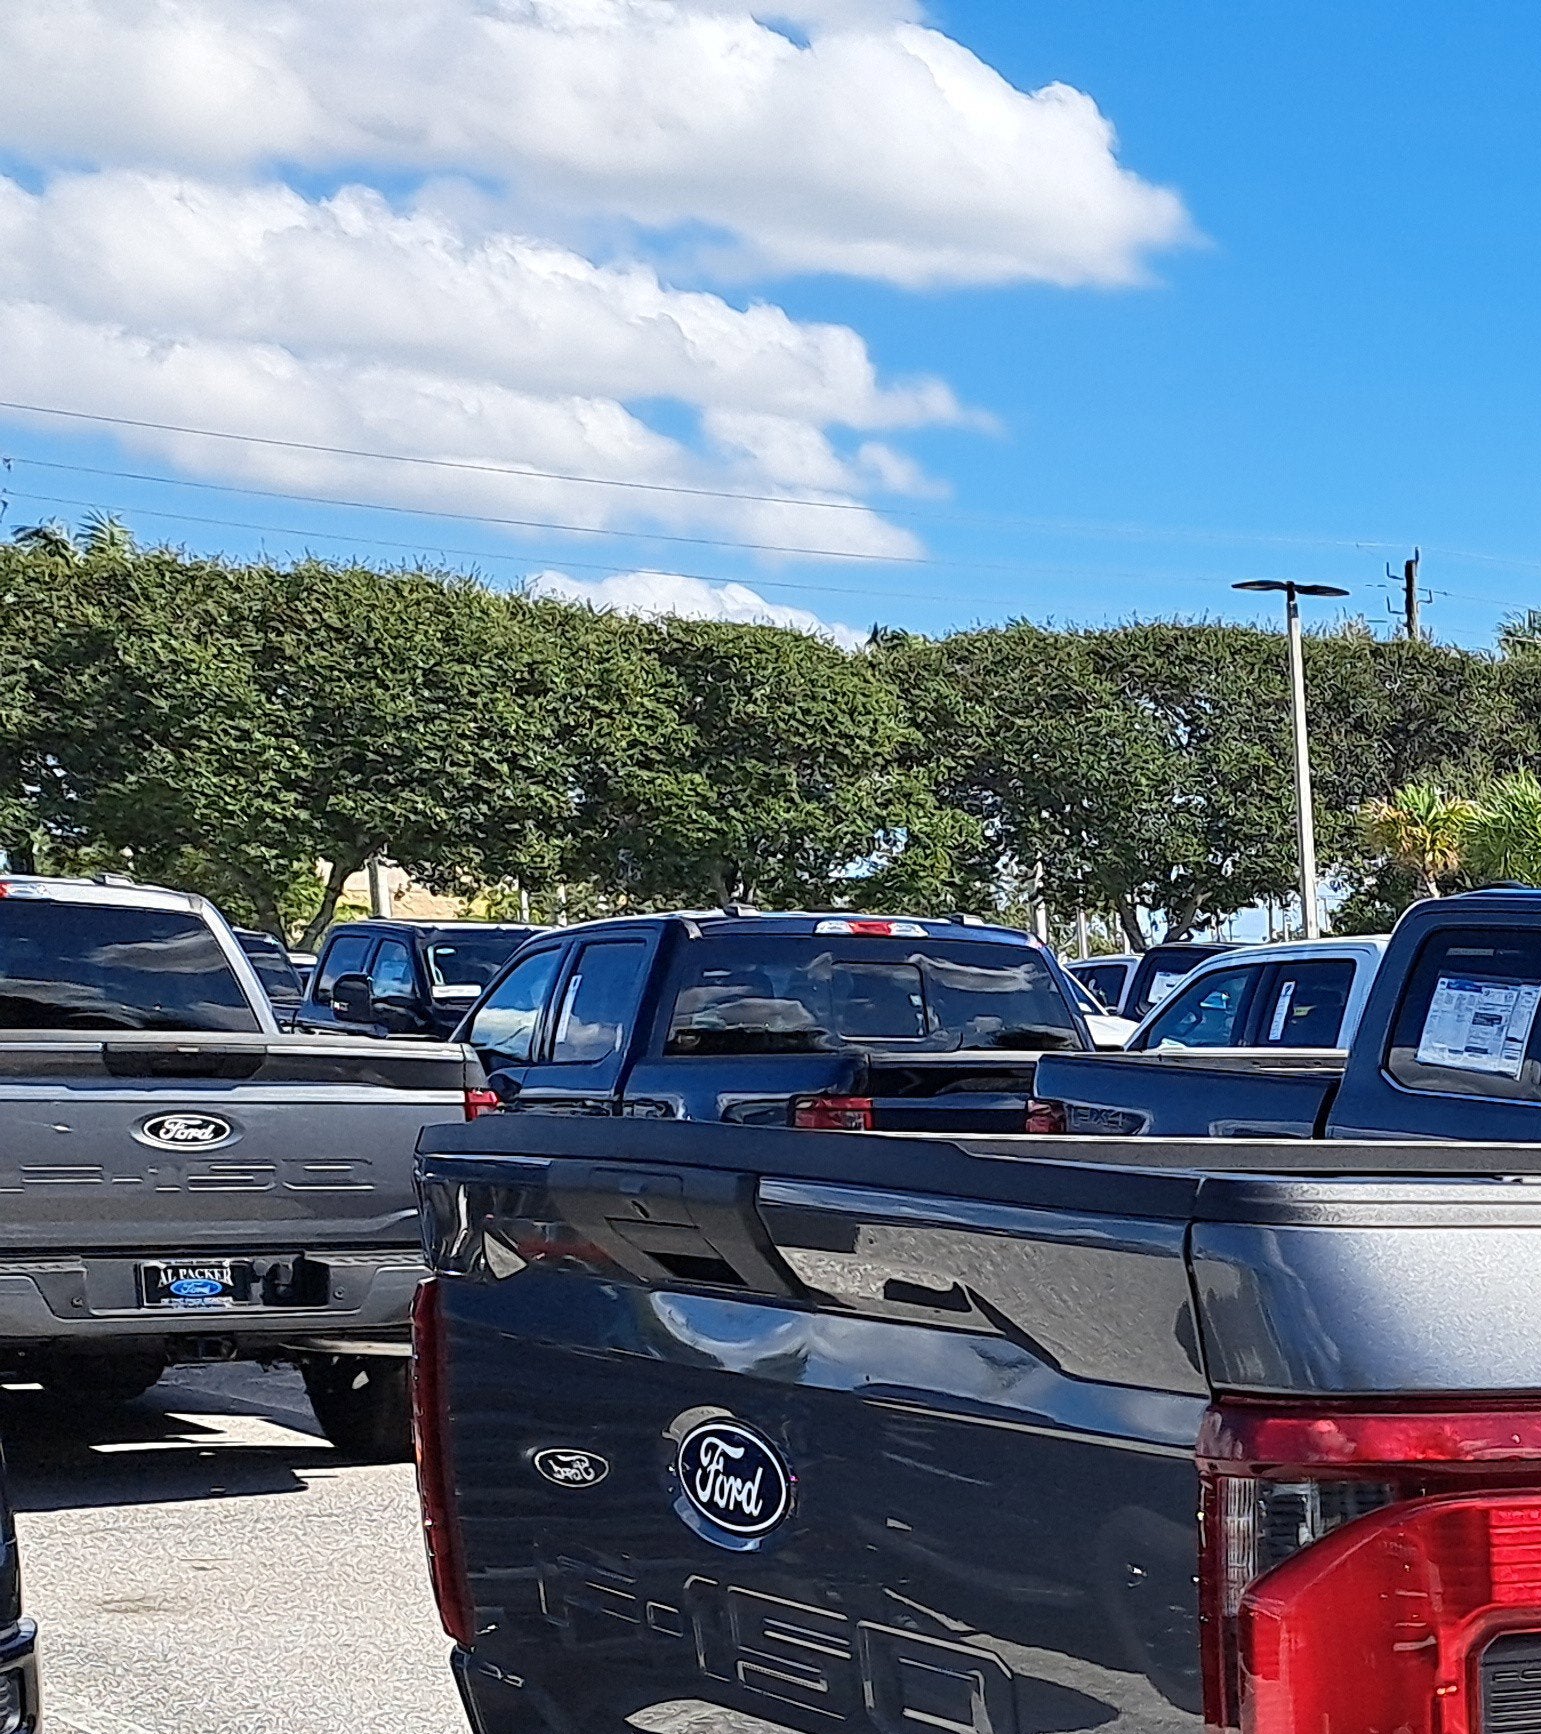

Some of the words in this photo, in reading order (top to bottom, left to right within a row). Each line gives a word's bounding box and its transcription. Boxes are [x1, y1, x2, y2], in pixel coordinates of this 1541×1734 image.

[159, 1118, 215, 1141] Ford
[157, 1268, 178, 1288] AL
[179, 1268, 235, 1287] PACKER
[181, 1281, 211, 1294] Ford
[695, 1436, 765, 1516] Ford
